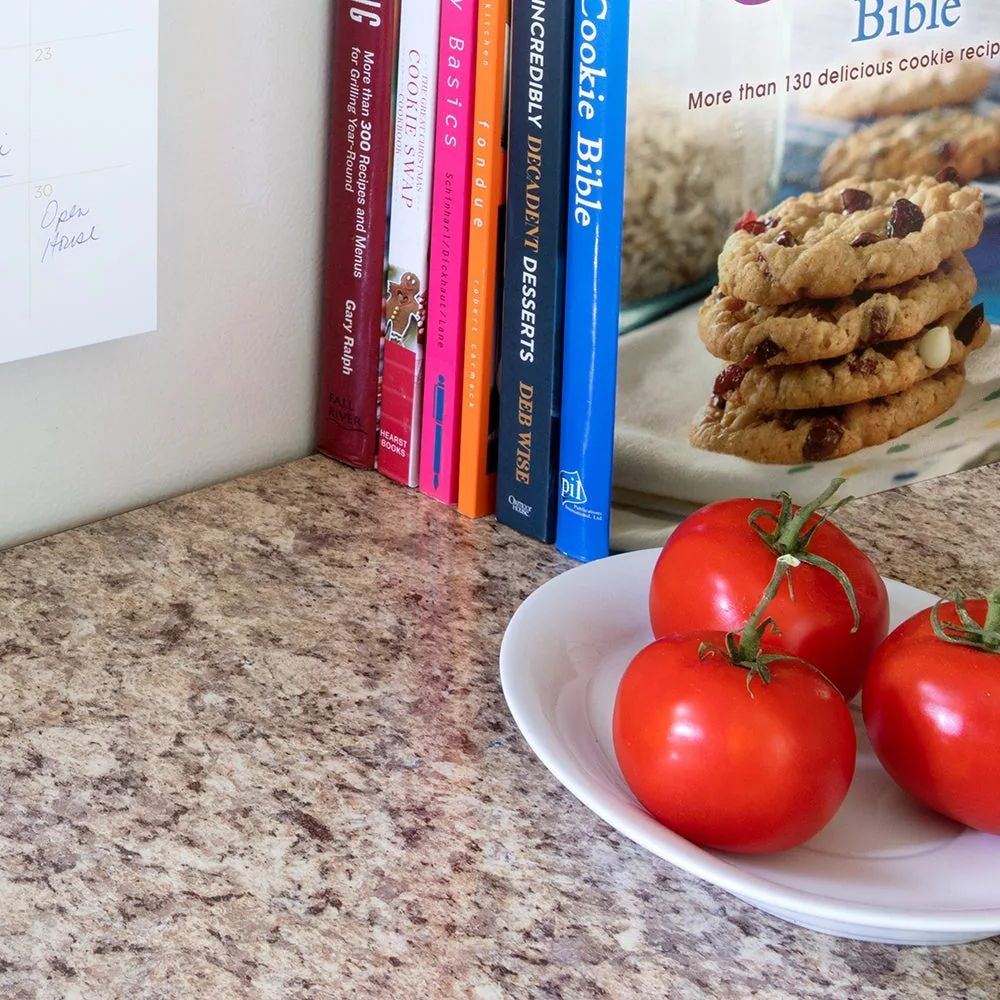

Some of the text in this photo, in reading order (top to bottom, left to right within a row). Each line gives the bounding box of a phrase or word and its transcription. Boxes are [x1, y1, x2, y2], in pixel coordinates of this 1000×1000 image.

[34, 46, 53, 63] 23
[445, 35, 465, 148] Basics
[688, 40, 1000, 111] More than 130 delicious cookie recip
[345, 46, 361, 193] for Grilling Year-Round
[353, 50, 375, 279] More than 300 Recipes and Menus
[401, 48, 421, 209] COOKIE SWAP
[34, 183, 53, 199] 30
[41, 200, 89, 232] Open
[474, 119, 490, 228] fondue
[524, 134, 543, 253] DECADENT
[574, 131, 603, 228] Bible
[41, 226, 100, 263] House
[342, 299, 356, 377] Gary Ralph
[519, 256, 537, 363] DESSERTS
[380, 429, 408, 448] HEARST
[380, 439, 406, 458] BOOKS
[515, 380, 534, 486] DEB WISE
